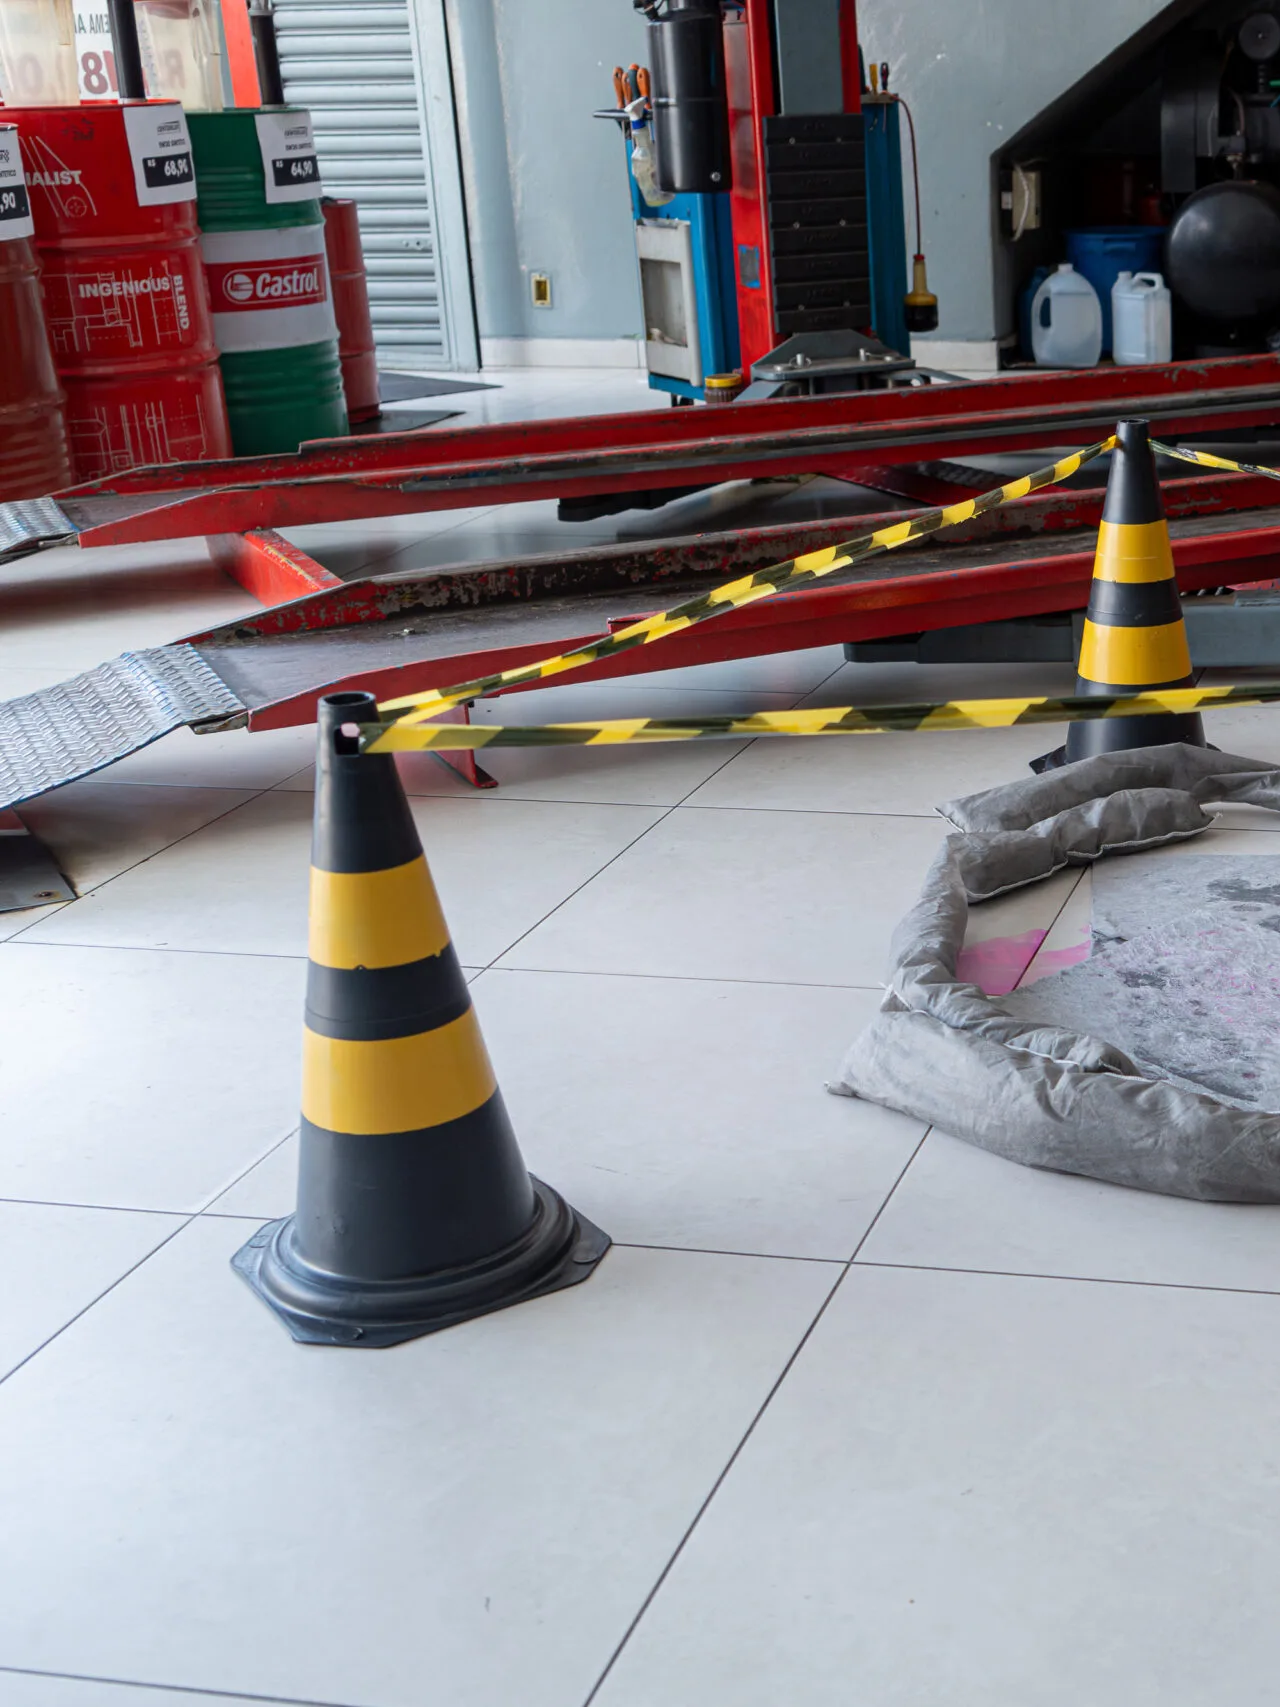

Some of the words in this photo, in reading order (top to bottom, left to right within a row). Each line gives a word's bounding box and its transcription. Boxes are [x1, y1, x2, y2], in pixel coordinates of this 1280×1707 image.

[25, 170, 82, 186] IALIST
[0, 192, 16, 213] ,90
[79, 277, 170, 299] INGENIOUS
[256, 268, 319, 299] Castrol
[174, 275, 190, 330] BLEND
